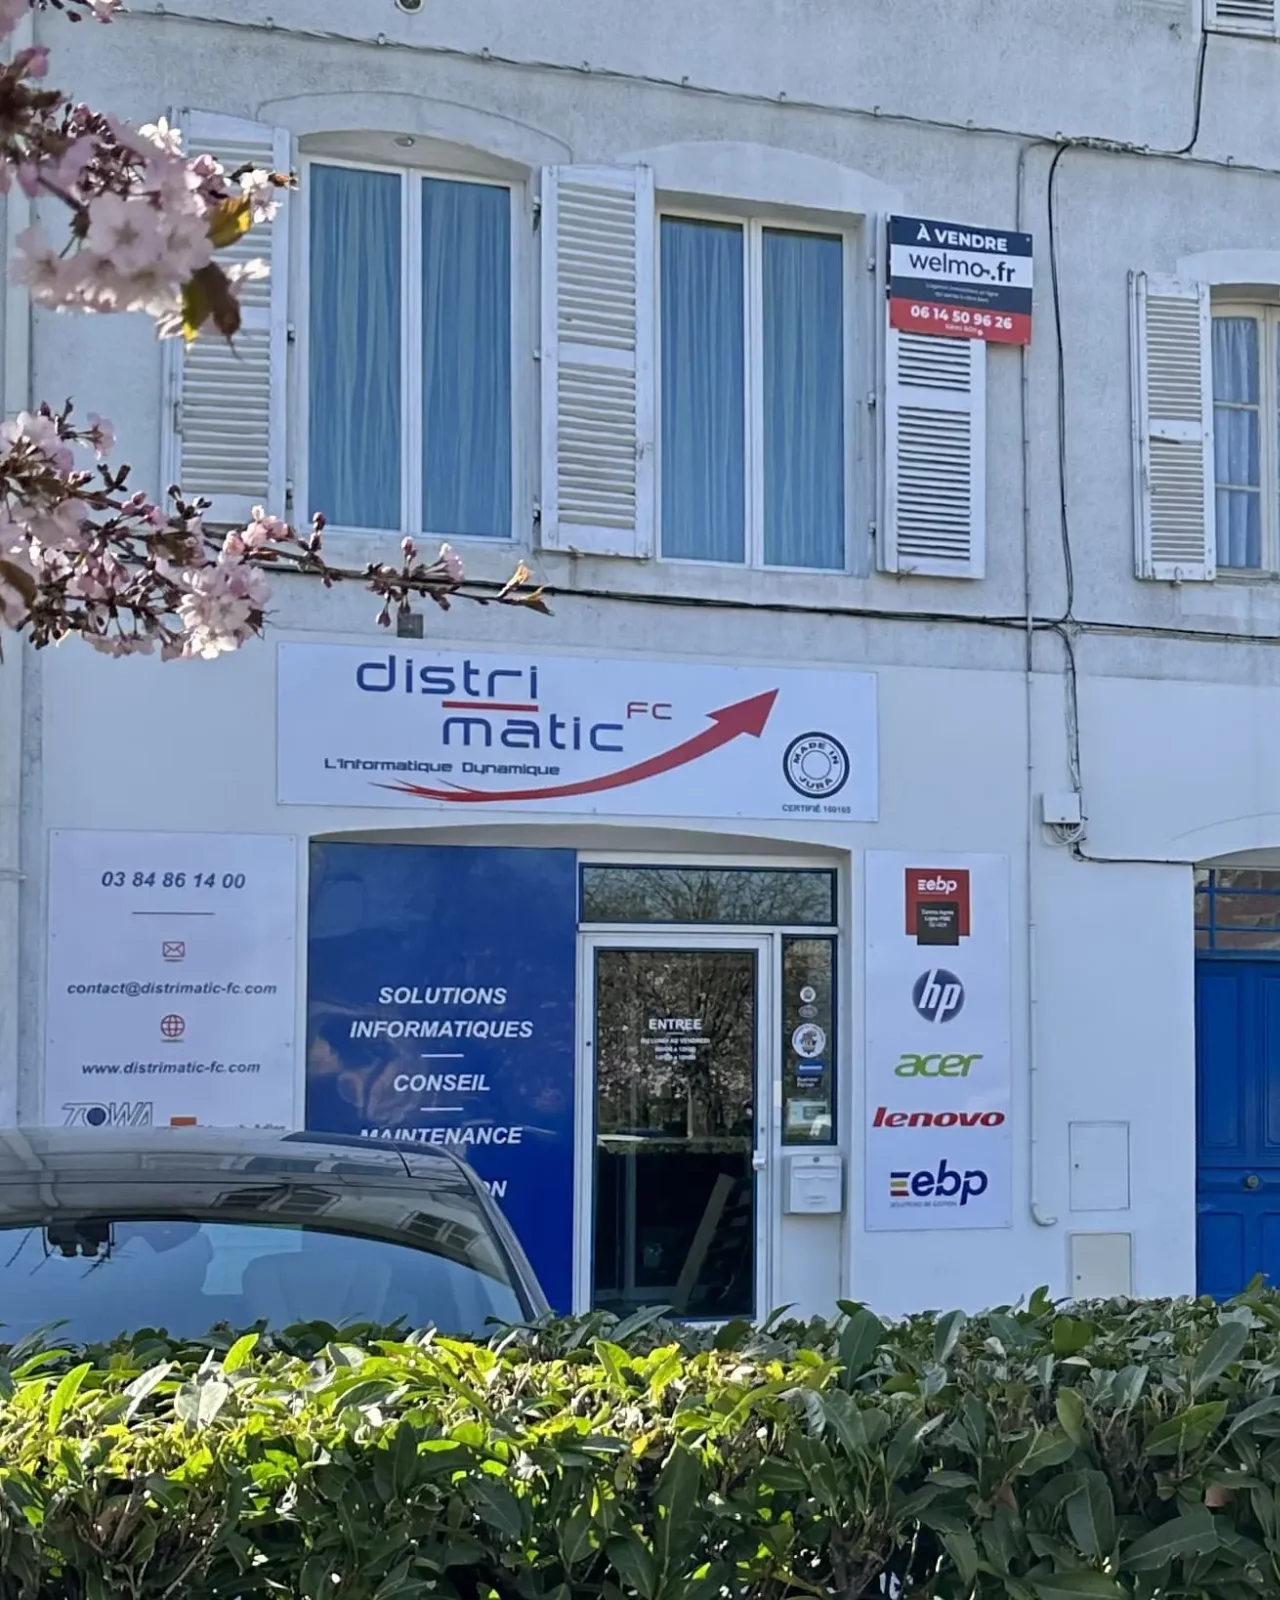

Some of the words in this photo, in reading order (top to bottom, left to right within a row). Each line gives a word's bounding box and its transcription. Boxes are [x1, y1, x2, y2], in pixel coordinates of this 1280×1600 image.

[916, 223, 931, 242] À
[934, 228, 1008, 252] VENDRE
[910, 304, 930, 319] 06
[933, 307, 949, 321] 14
[952, 310, 970, 324] 50
[973, 313, 992, 328] 96
[995, 316, 1013, 330] 26
[356, 654, 538, 700] distri
[443, 713, 624, 752] matic
[627, 701, 672, 720] FC
[793, 742, 826, 765] MADE
[828, 750, 840, 765] IN
[462, 761, 560, 777] Dynamique
[799, 776, 834, 790] JURA
[101, 870, 126, 887] 03
[132, 871, 156, 888] 84
[162, 872, 187, 888] 86
[193, 873, 215, 888] 14
[222, 873, 246, 889] 00
[67, 981, 277, 997] contact@distrimatic-fc.com
[378, 986, 507, 1005] SOLUTIONS
[918, 969, 961, 1022] hp
[350, 1020, 533, 1039] INFORMATIQUES
[648, 1018, 703, 1031] ENTREE
[81, 1060, 261, 1076] www.distrimatic-fc.com
[894, 1053, 984, 1078] acer
[393, 1073, 491, 1092] CONSEIL
[872, 1106, 1005, 1128] lenovo
[911, 1159, 988, 1206] ebp
